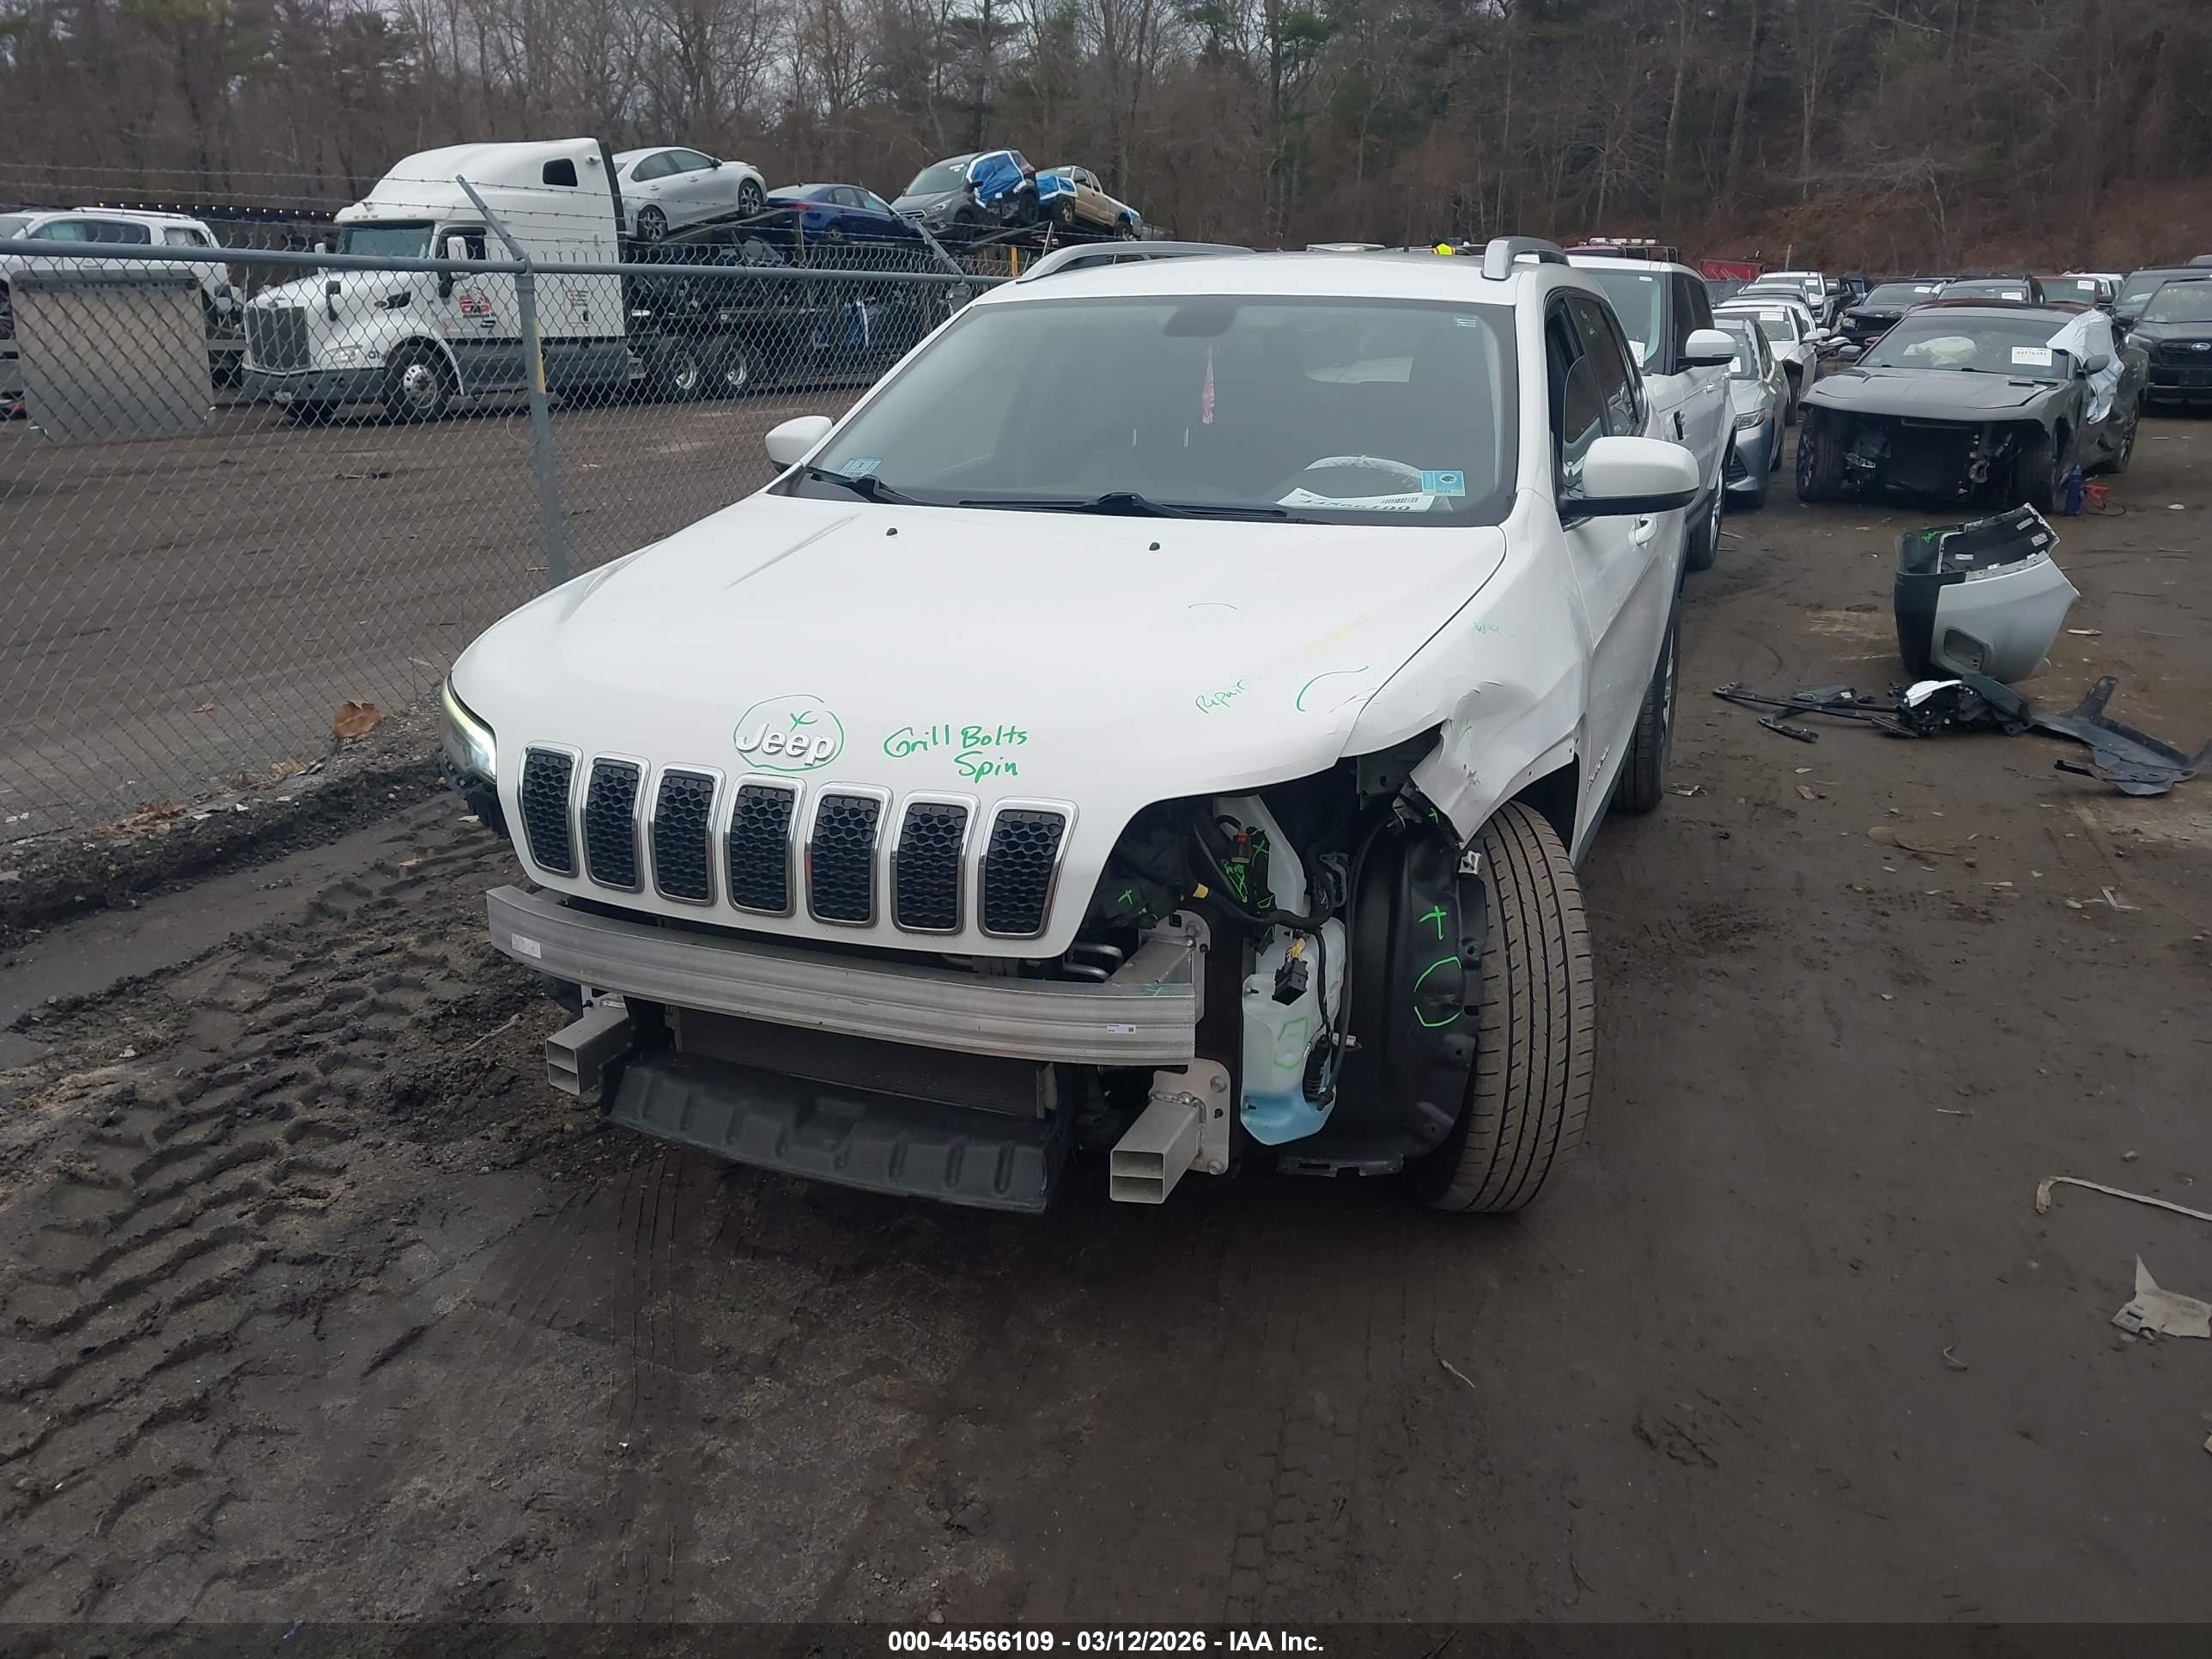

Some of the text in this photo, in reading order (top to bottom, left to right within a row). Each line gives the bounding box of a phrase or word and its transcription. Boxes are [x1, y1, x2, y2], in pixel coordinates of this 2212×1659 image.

[734, 722, 836, 767] Jeep
[883, 724, 1029, 758] Grill Bolts
[953, 750, 1019, 784] Spin
